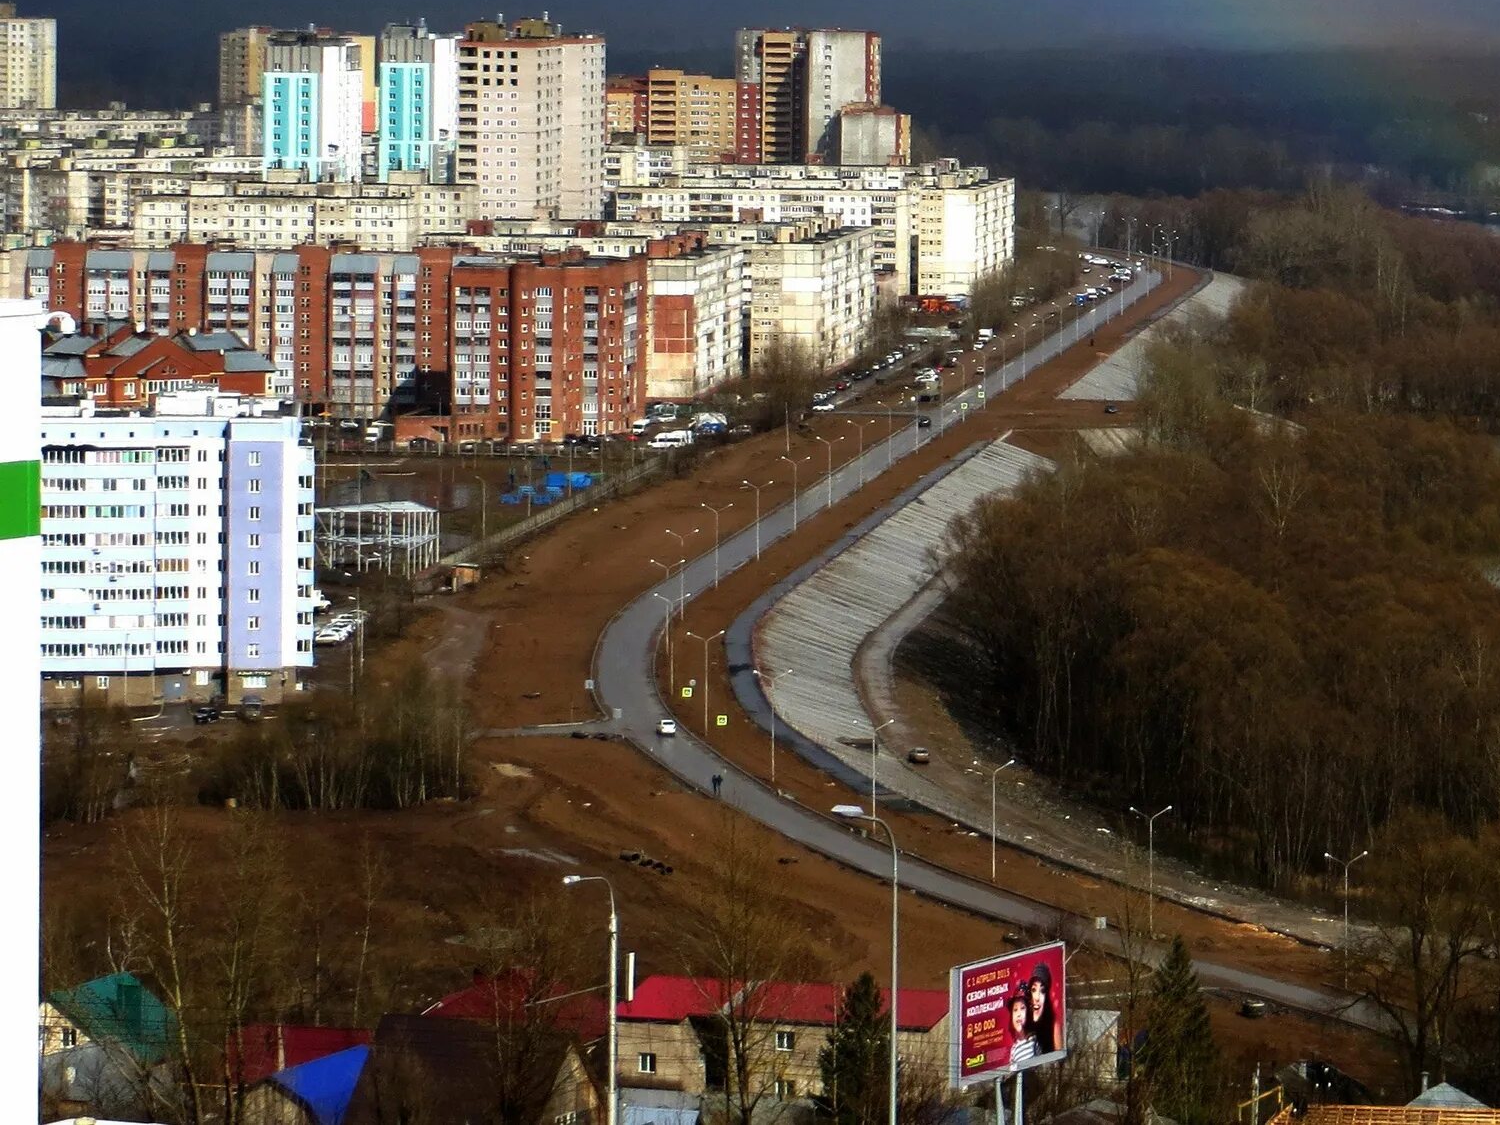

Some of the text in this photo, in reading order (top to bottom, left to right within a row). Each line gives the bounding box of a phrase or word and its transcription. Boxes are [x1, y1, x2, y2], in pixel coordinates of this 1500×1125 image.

[966, 983, 1009, 1002] СЕЗОН НОВЫХ
[967, 997, 1004, 1017] КОЛЛЕКЦИЙ
[974, 1018, 996, 1033] 50 000
